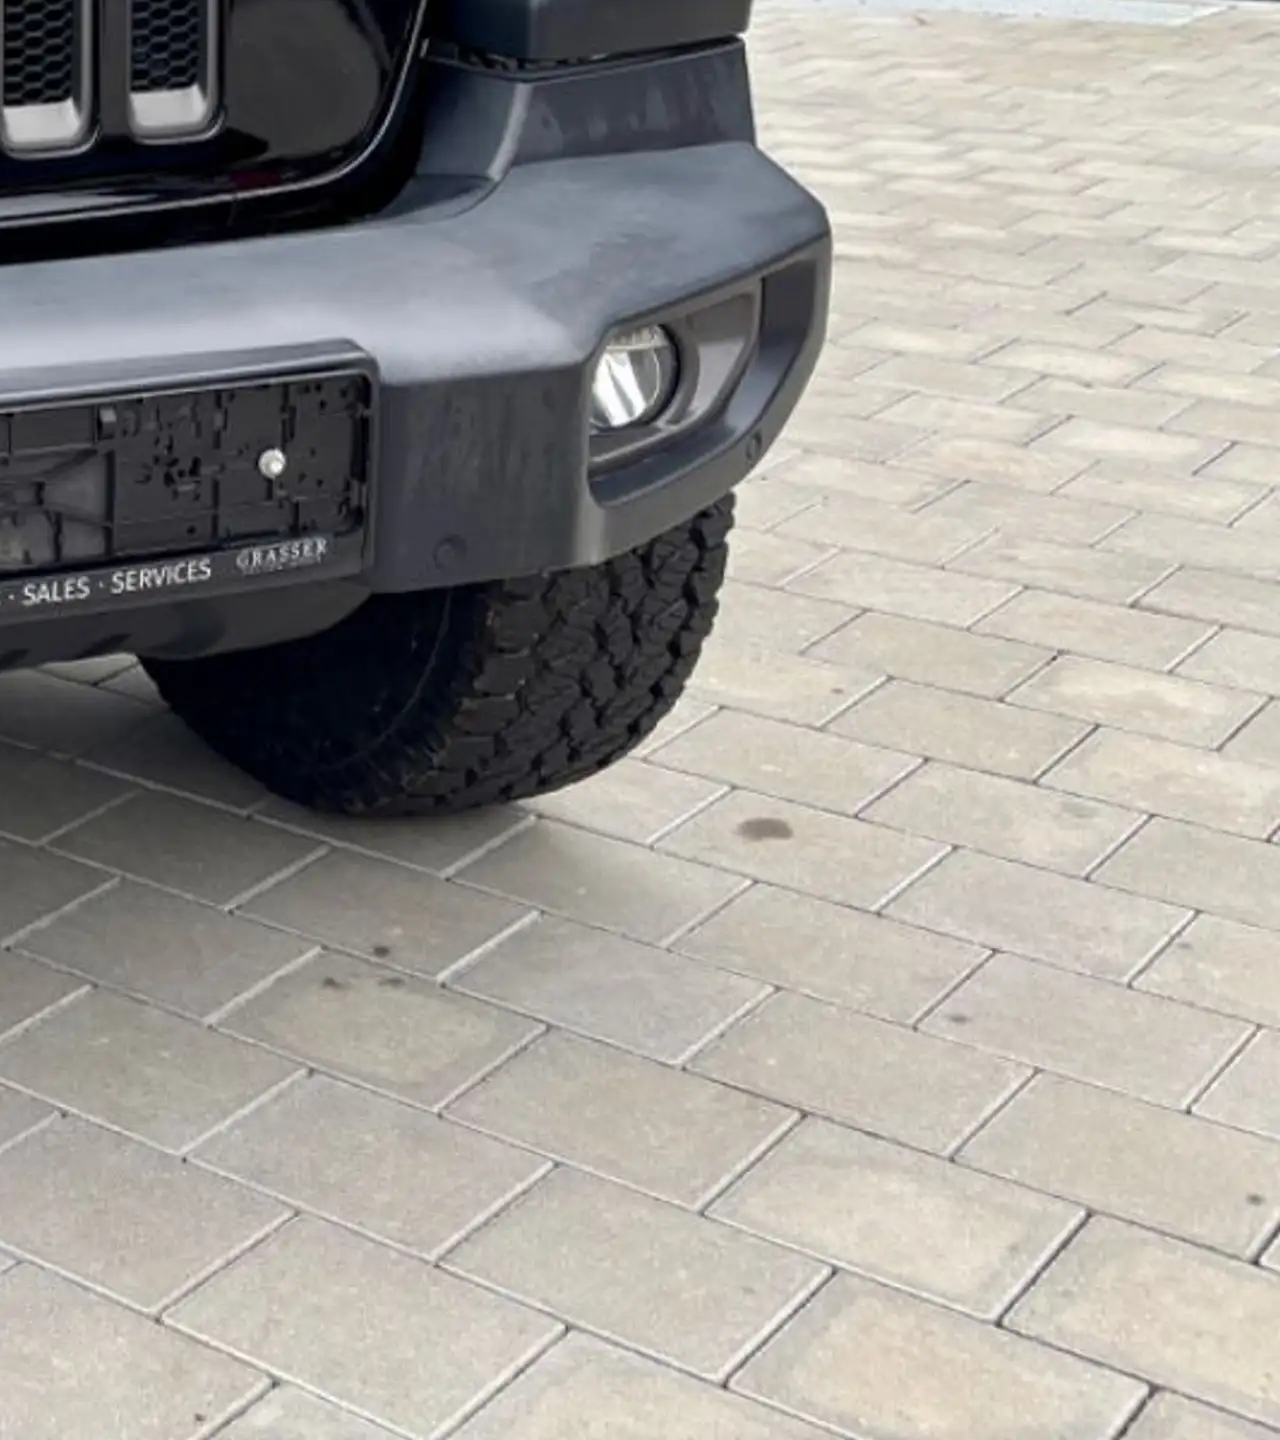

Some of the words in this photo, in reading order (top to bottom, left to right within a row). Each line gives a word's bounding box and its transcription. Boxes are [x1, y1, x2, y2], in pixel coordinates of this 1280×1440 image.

[236, 537, 328, 568] GRASSER
[22, 576, 90, 606] SALES
[110, 558, 212, 594] SERVICES
